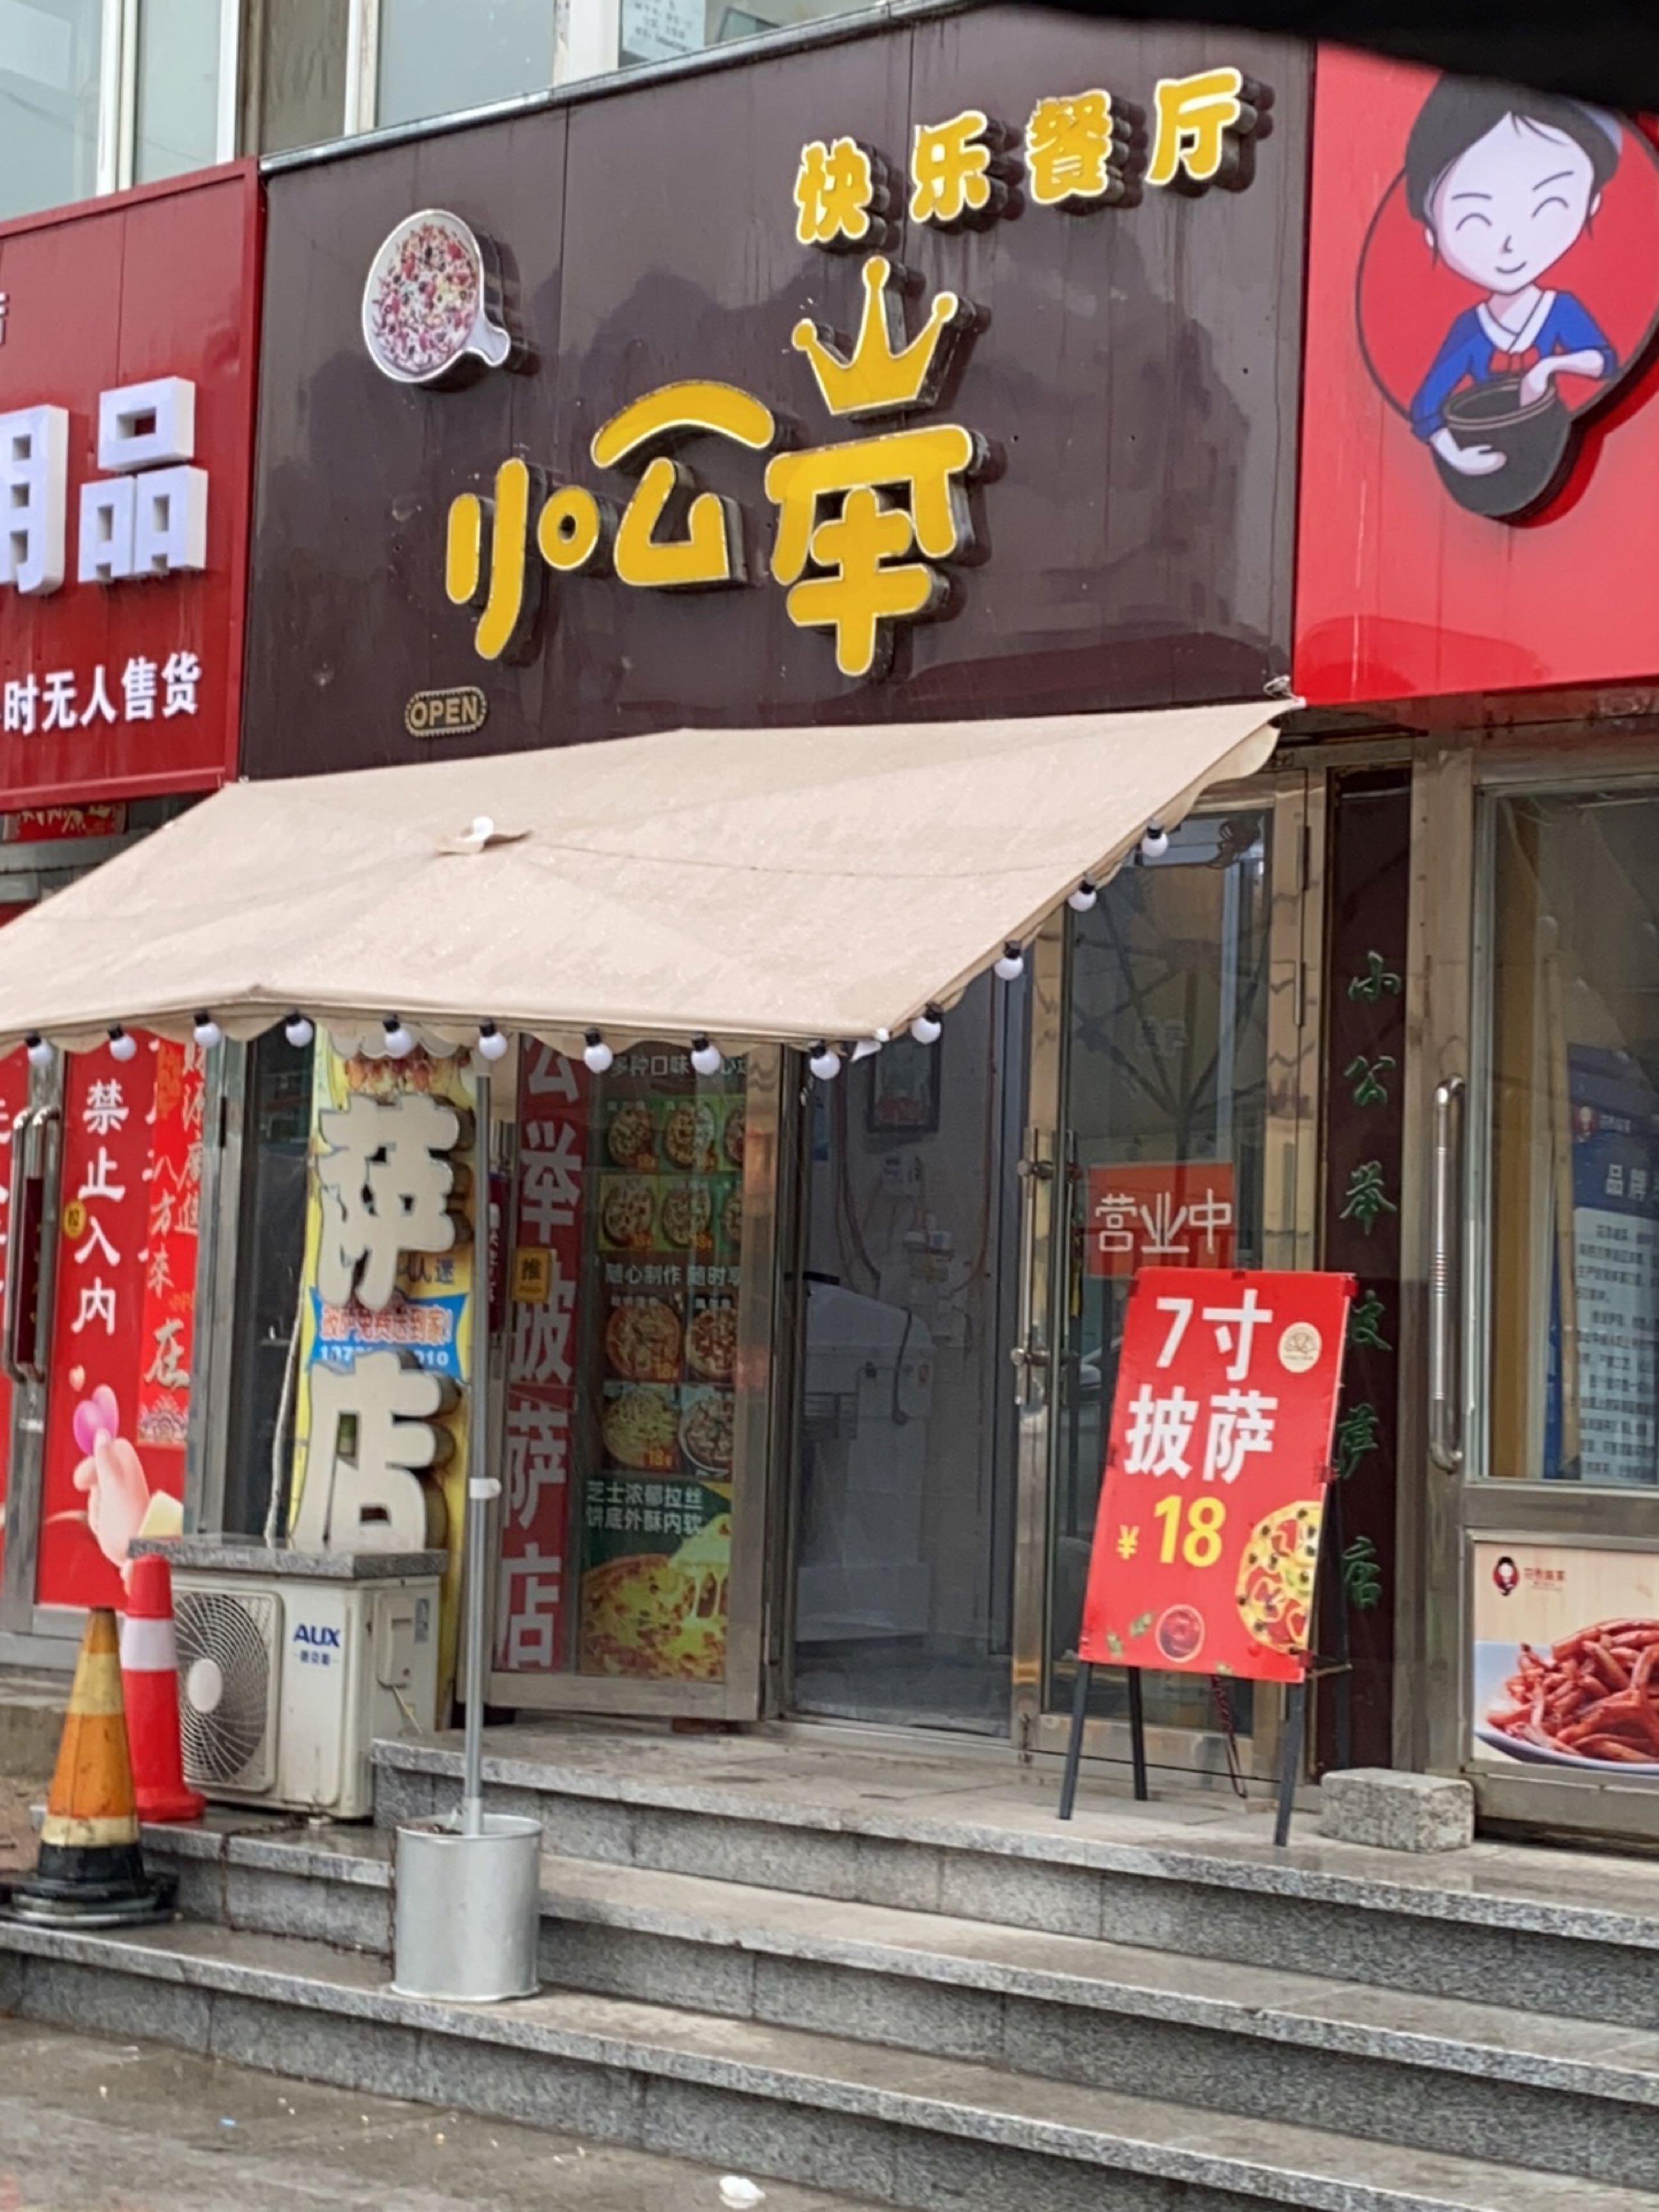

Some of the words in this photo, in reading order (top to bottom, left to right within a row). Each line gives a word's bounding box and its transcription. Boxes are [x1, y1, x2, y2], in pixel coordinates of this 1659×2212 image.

[794, 67, 1242, 243] 快乐餐厅
[410, 694, 479, 728] OPEN
[71, 1078, 129, 1336] 禁止入内
[1095, 1189, 1232, 1254] 营业中
[1156, 1288, 1274, 1381] 7寸
[1124, 1383, 1278, 1484] 披萨
[293, 1623, 341, 1648] AUX
